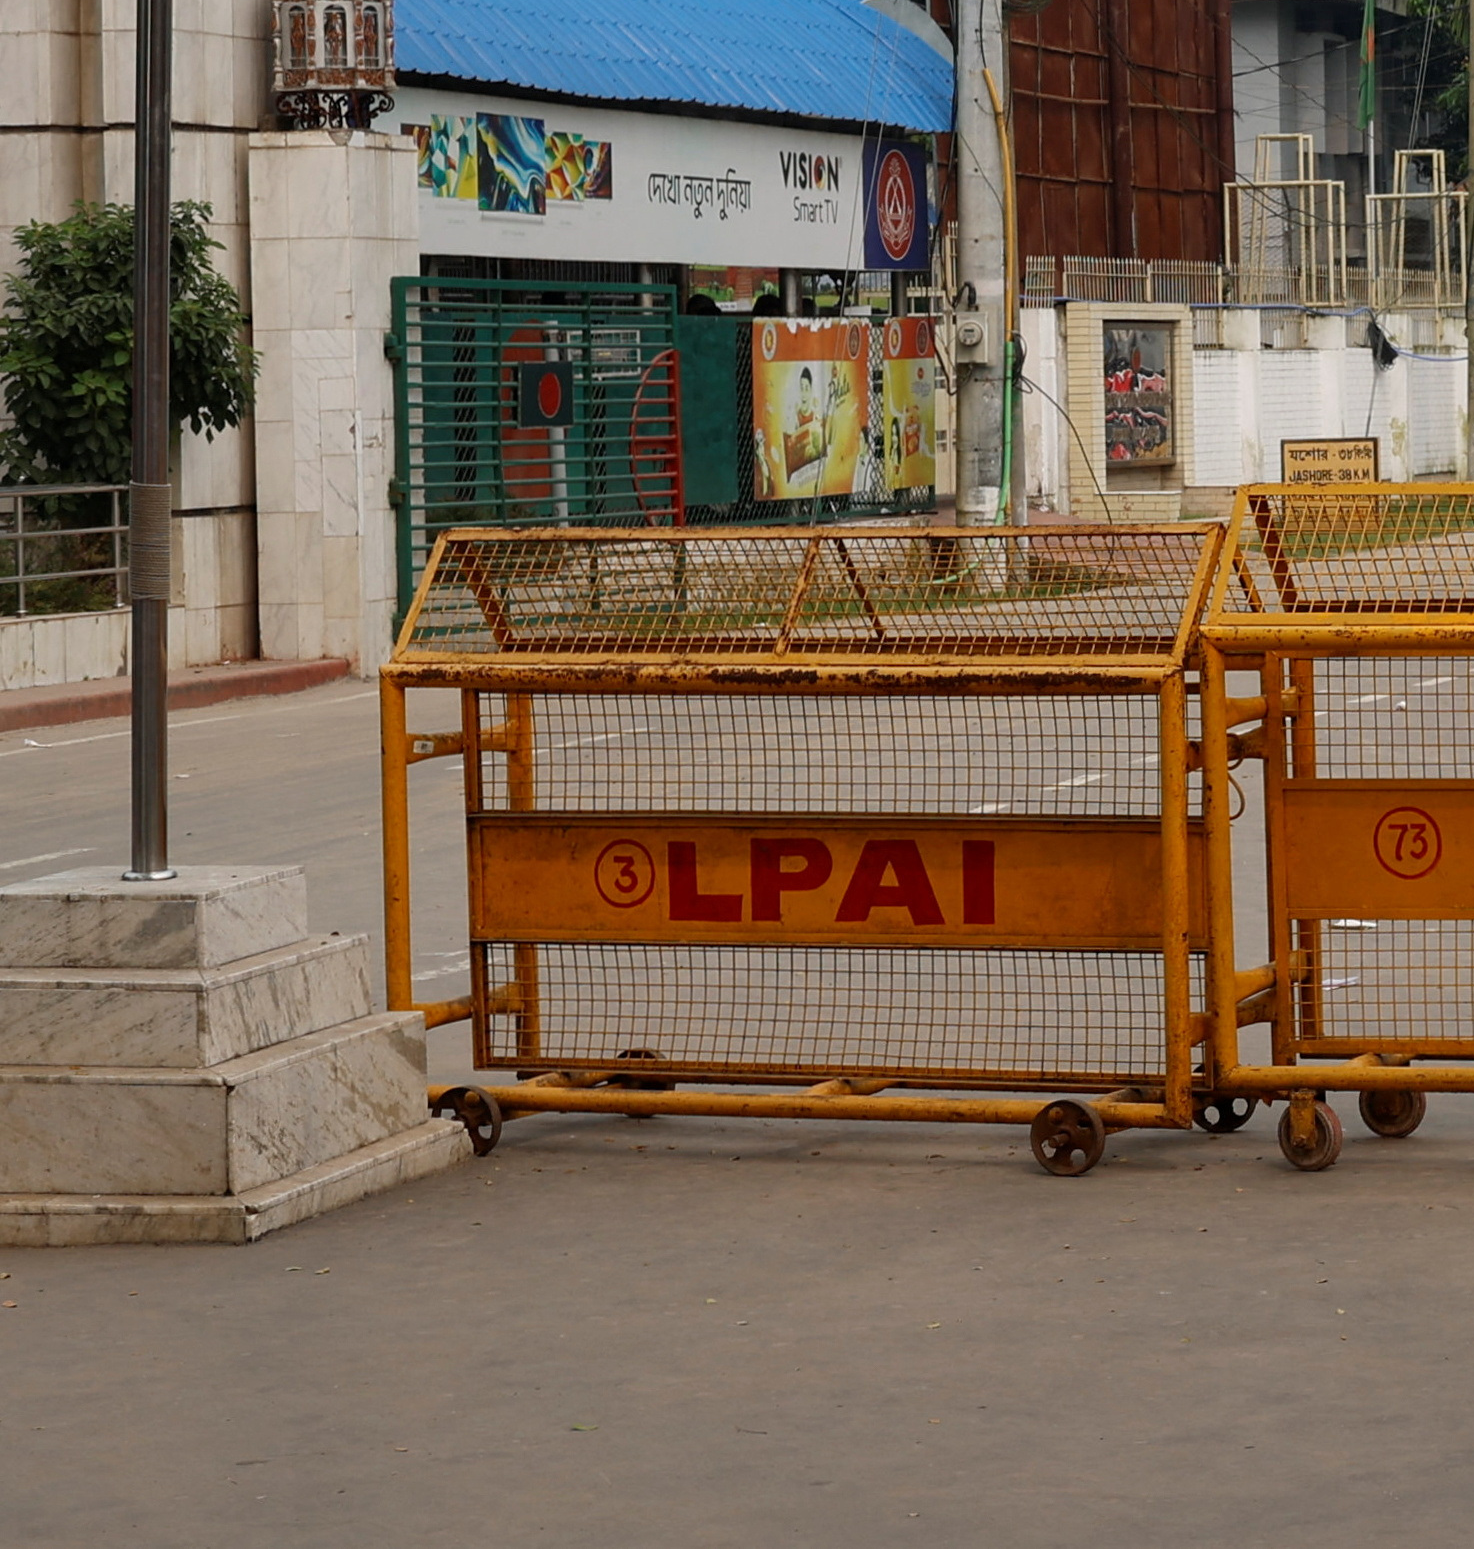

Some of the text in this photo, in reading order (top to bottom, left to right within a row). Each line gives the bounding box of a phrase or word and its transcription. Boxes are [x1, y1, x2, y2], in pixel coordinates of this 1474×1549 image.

[779, 150, 840, 192] VISION
[648, 168, 751, 220] দেখো নতুন দুনিয়া
[793, 197, 839, 225] Smart TV
[1288, 447, 1328, 461] যশোর
[667, 837, 996, 926] LPAI
